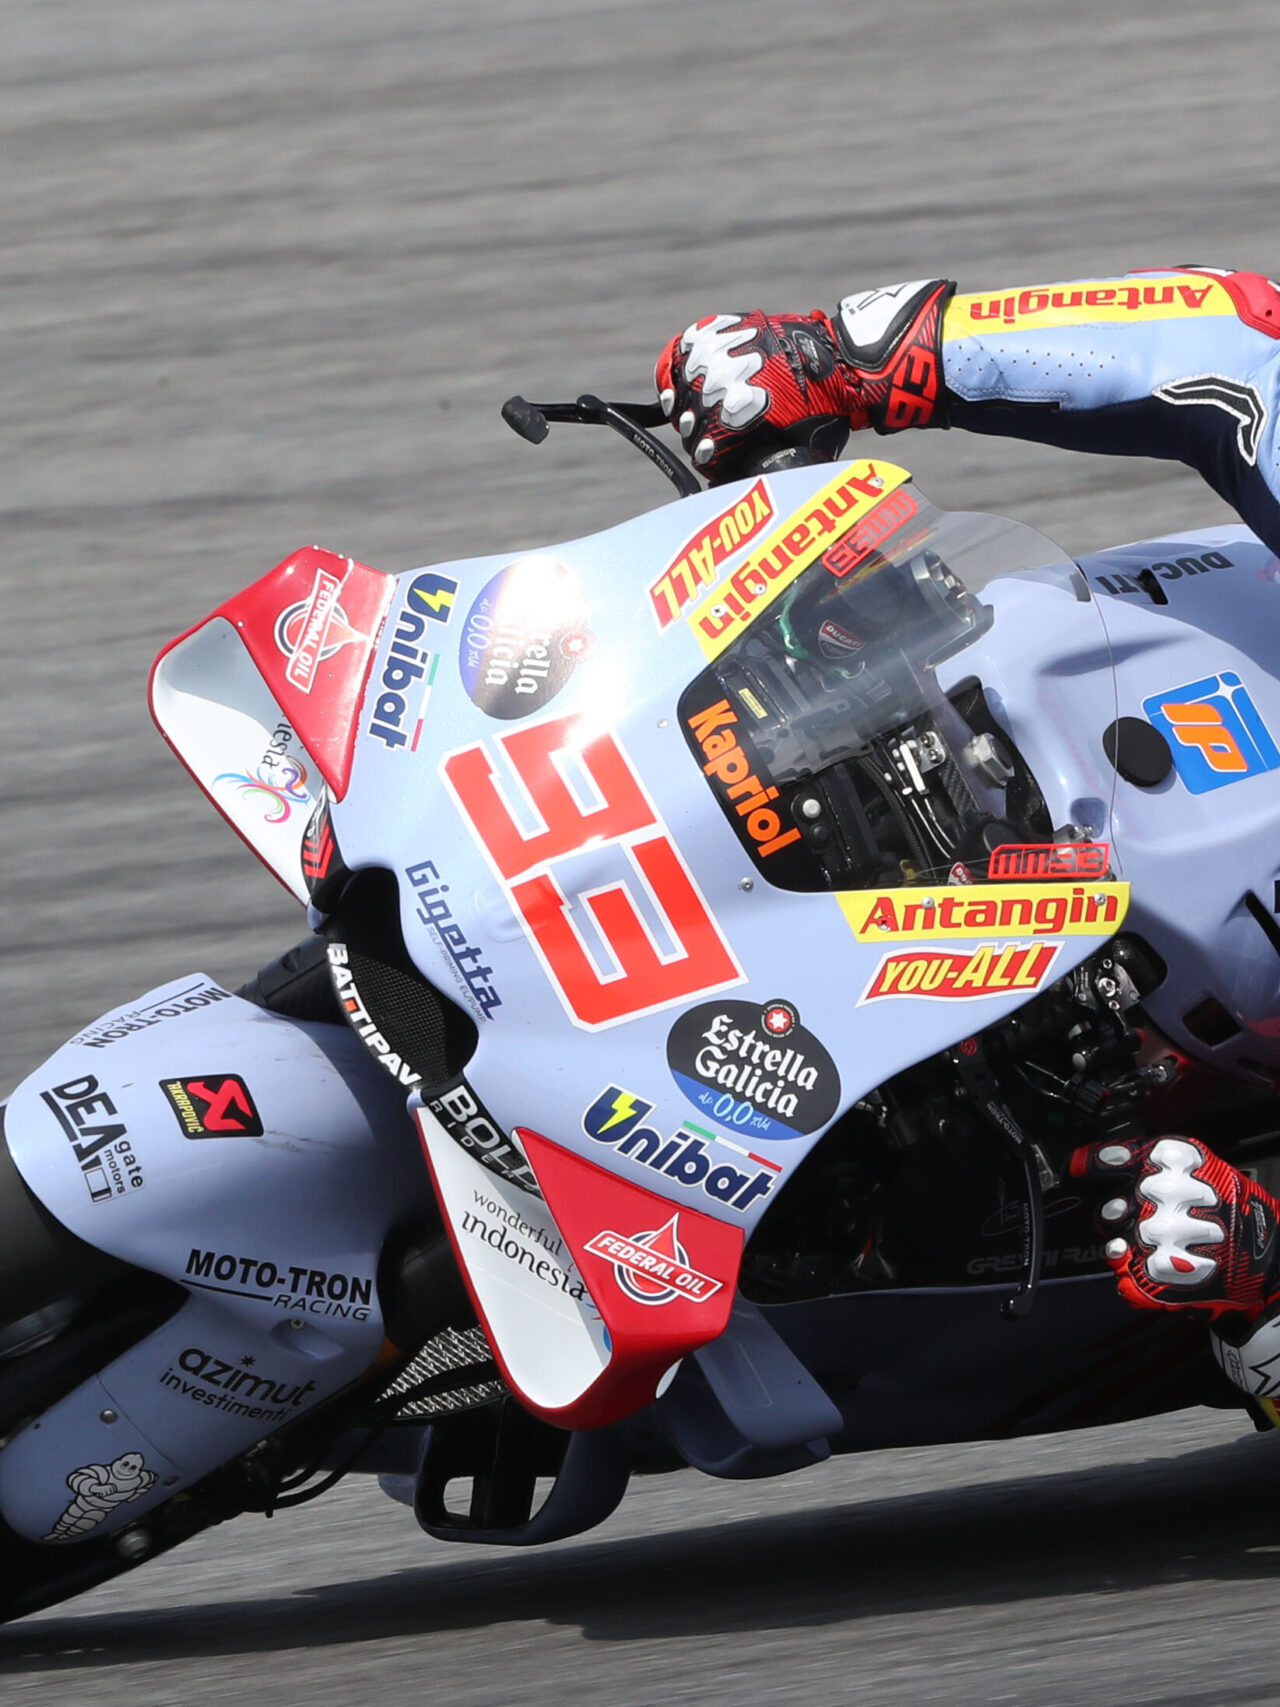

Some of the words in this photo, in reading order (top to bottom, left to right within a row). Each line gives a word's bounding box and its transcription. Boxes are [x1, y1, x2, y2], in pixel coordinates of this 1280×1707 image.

[970, 284, 1215, 325] Antangin
[653, 489, 771, 622] YOU-ALL
[698, 463, 886, 640] Antangin
[294, 656, 313, 681] OIL
[368, 573, 459, 749] Unibat
[687, 699, 801, 858] Kapriol
[405, 860, 502, 1022] Gigetta
[860, 887, 1119, 935] Antangin
[882, 942, 1047, 992] YOU-ALL
[83, 987, 233, 1049] MOTO-TRON
[695, 1045, 799, 1118] Galicia
[701, 1014, 819, 1092] Estrella
[439, 1084, 541, 1190] BOLD
[713, 1094, 753, 1126] 0,0
[104, 1149, 126, 1194] motors
[115, 1140, 144, 1188] gate
[582, 1082, 779, 1213] Unibat
[473, 1188, 563, 1257] wonderful
[184, 1249, 373, 1305] MOTO-TRON
[461, 1210, 590, 1301] indonesia
[597, 1236, 674, 1281] FEDERAL
[674, 1271, 706, 1294] OIL
[272, 1293, 373, 1321] RACING
[159, 1367, 292, 1422] investimenti
[178, 1347, 316, 1407] azimut
